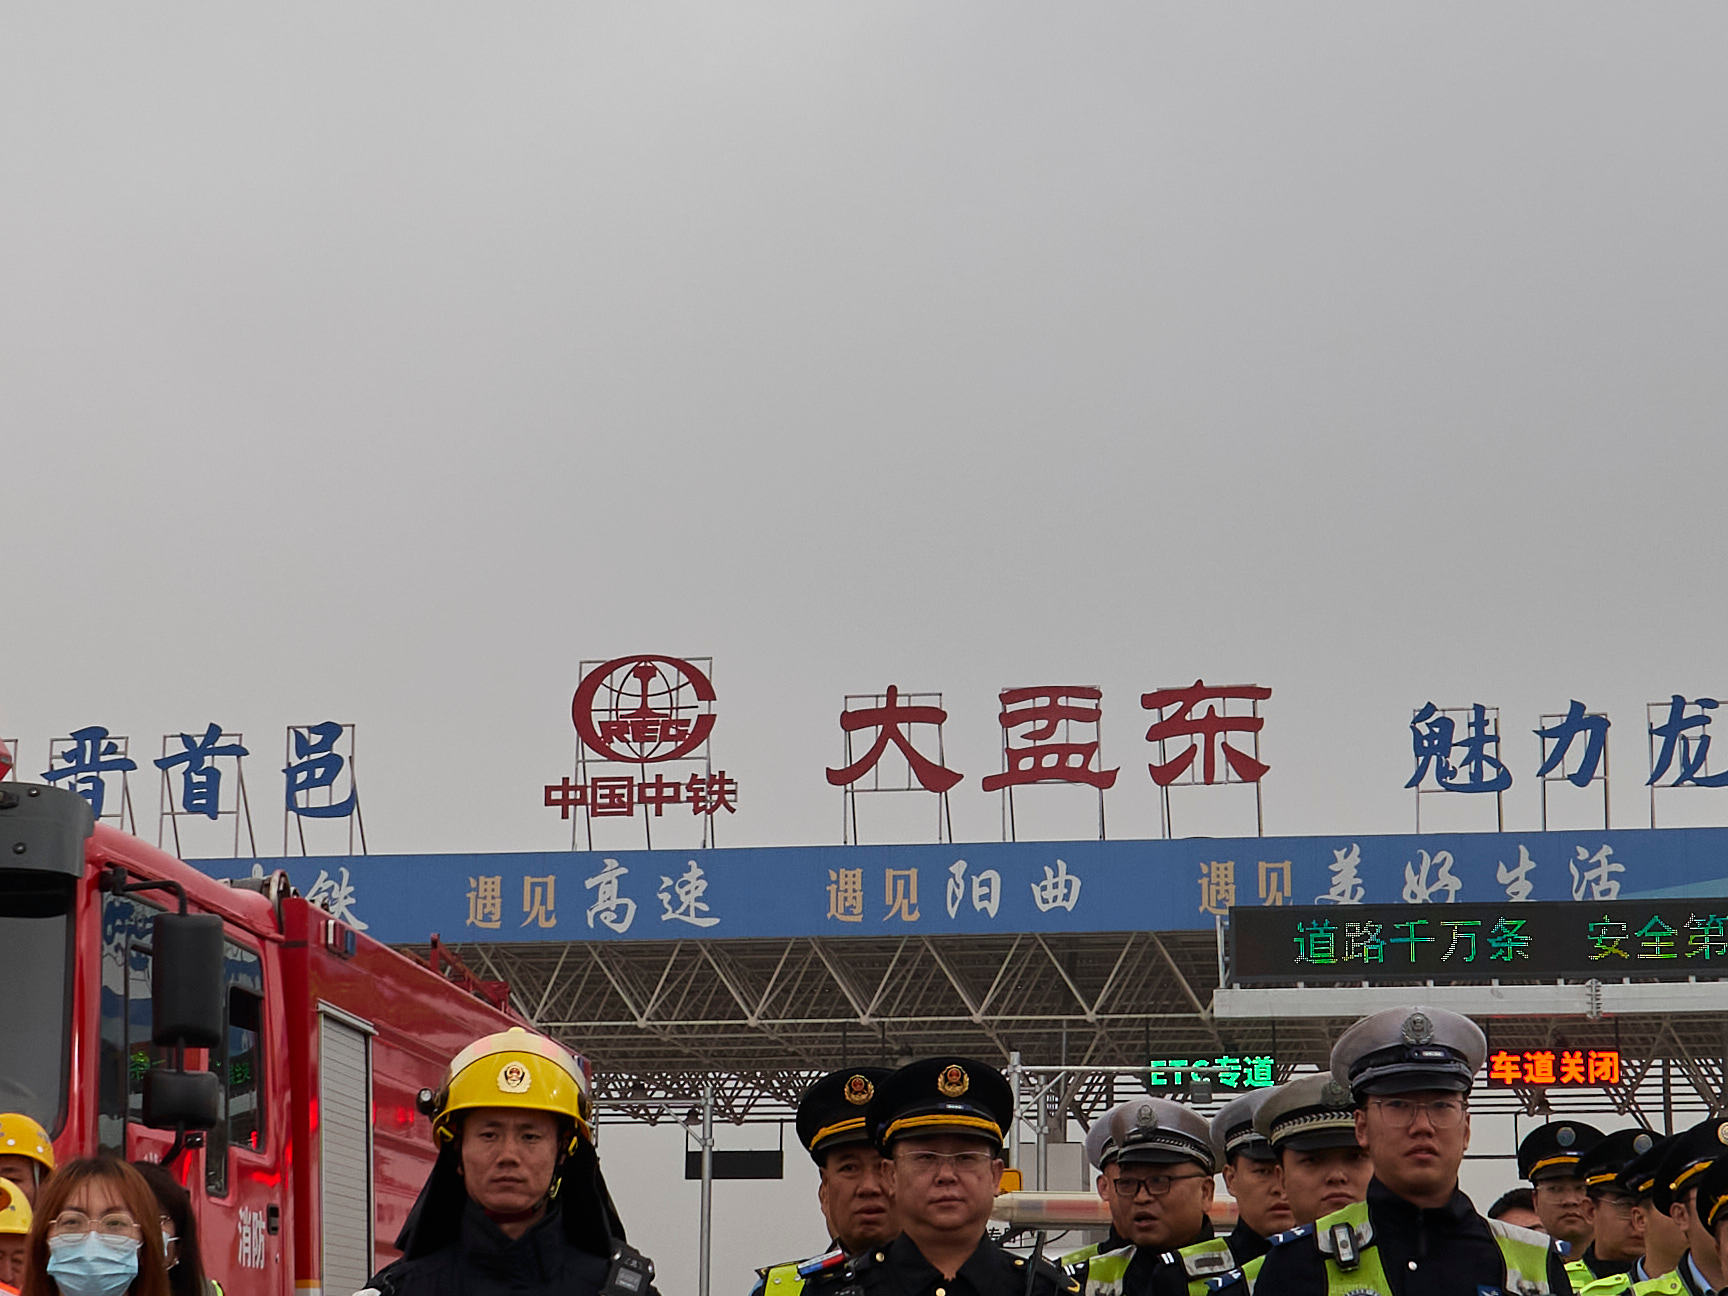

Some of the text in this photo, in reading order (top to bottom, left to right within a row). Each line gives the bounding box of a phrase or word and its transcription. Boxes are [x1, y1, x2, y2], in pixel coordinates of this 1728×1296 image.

[543, 769, 738, 820] 中国中铁
[825, 858, 1083, 923] 遇见阳曲
[1292, 915, 1533, 964] 道路千万条
[1488, 1049, 1621, 1086] 车道关闭
[237, 1206, 266, 1270] 消防
